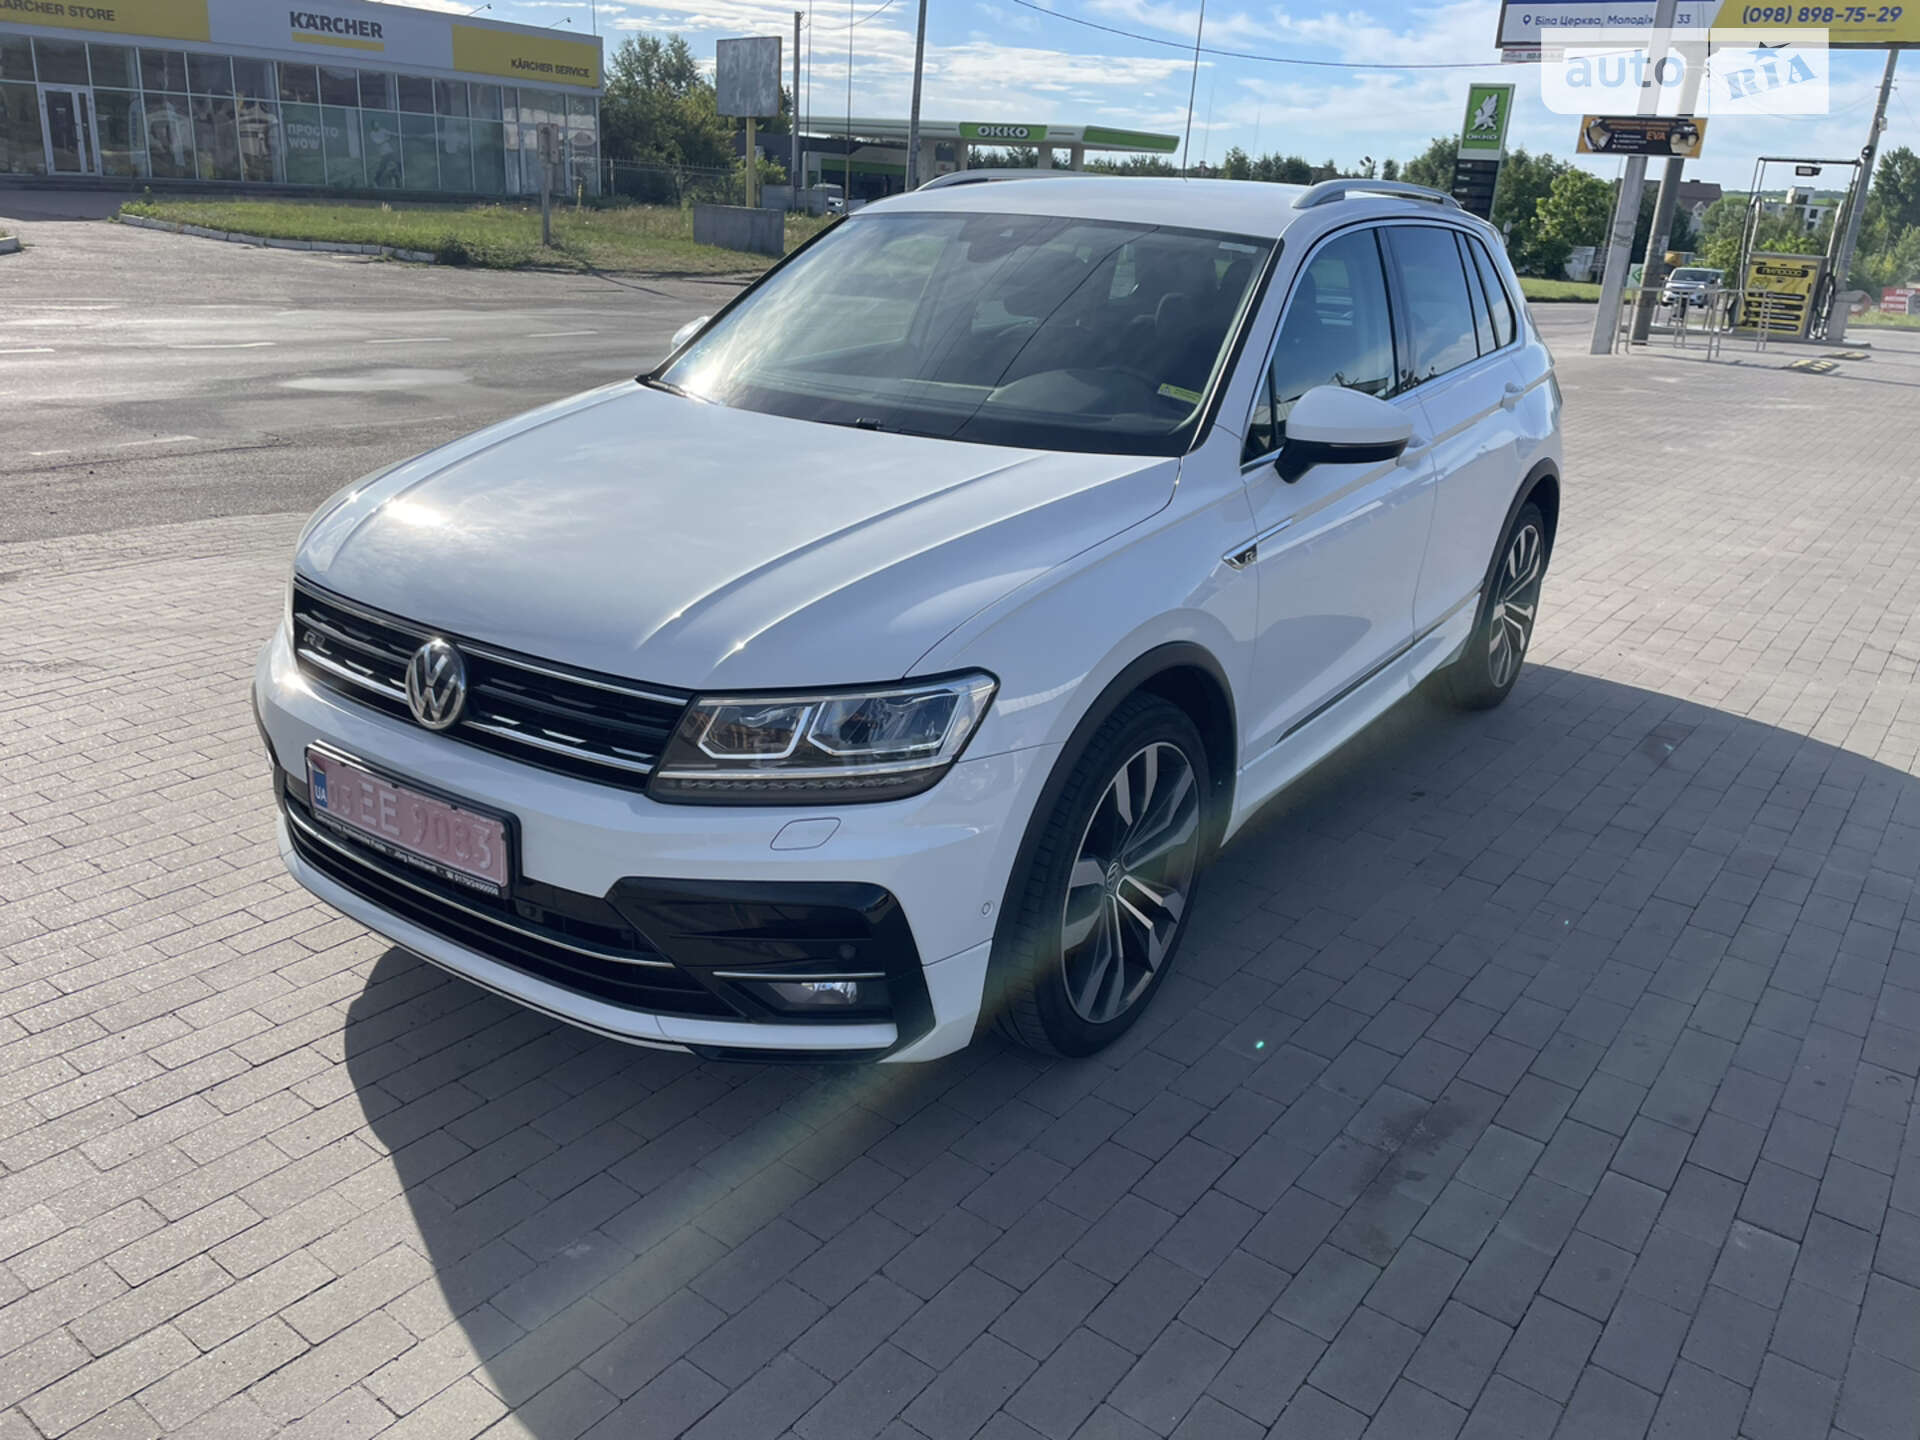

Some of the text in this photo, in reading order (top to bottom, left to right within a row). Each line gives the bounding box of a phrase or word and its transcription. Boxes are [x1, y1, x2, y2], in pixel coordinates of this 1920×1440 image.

[0, 0, 116, 21] ARCHER STORE
[1534, 15, 1557, 25] Біла
[1677, 14, 1691, 24] 33
[1742, 6, 1903, 24] (098) 898-75-29
[289, 11, 383, 38] KÄRCHER
[555, 64, 590, 78] SERVICE
[977, 125, 1029, 139] OKKO
[314, 784, 327, 803] UA
[359, 781, 401, 836] EE
